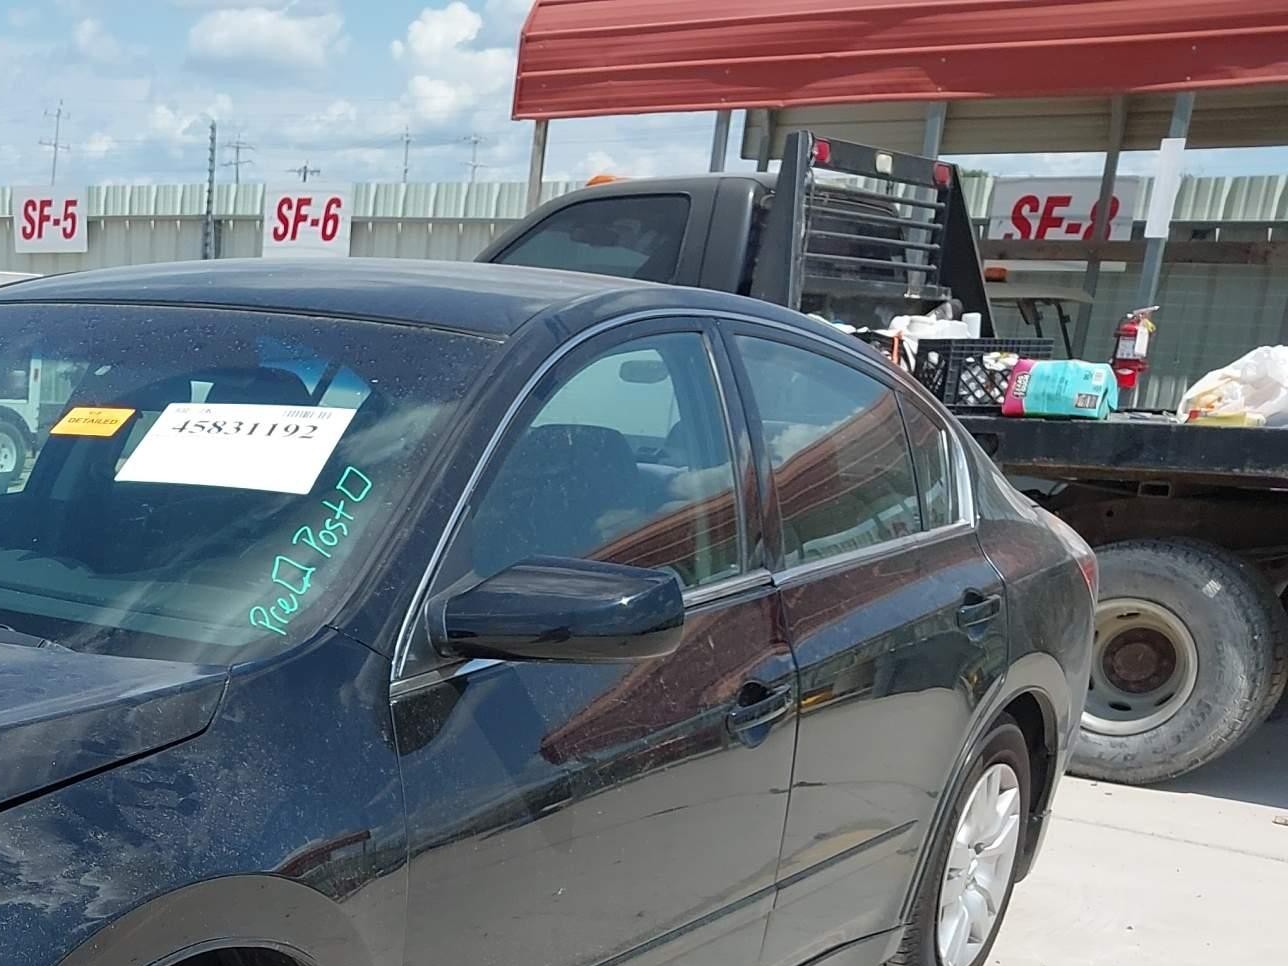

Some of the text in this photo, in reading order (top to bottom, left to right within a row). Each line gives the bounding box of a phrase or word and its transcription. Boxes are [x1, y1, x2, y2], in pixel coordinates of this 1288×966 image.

[22, 198, 78, 240] SF-5
[273, 197, 341, 242] SF-6
[67, 417, 119, 425] DETAILED
[172, 419, 318, 439] 45831192
[249, 499, 355, 636] Pre Post
